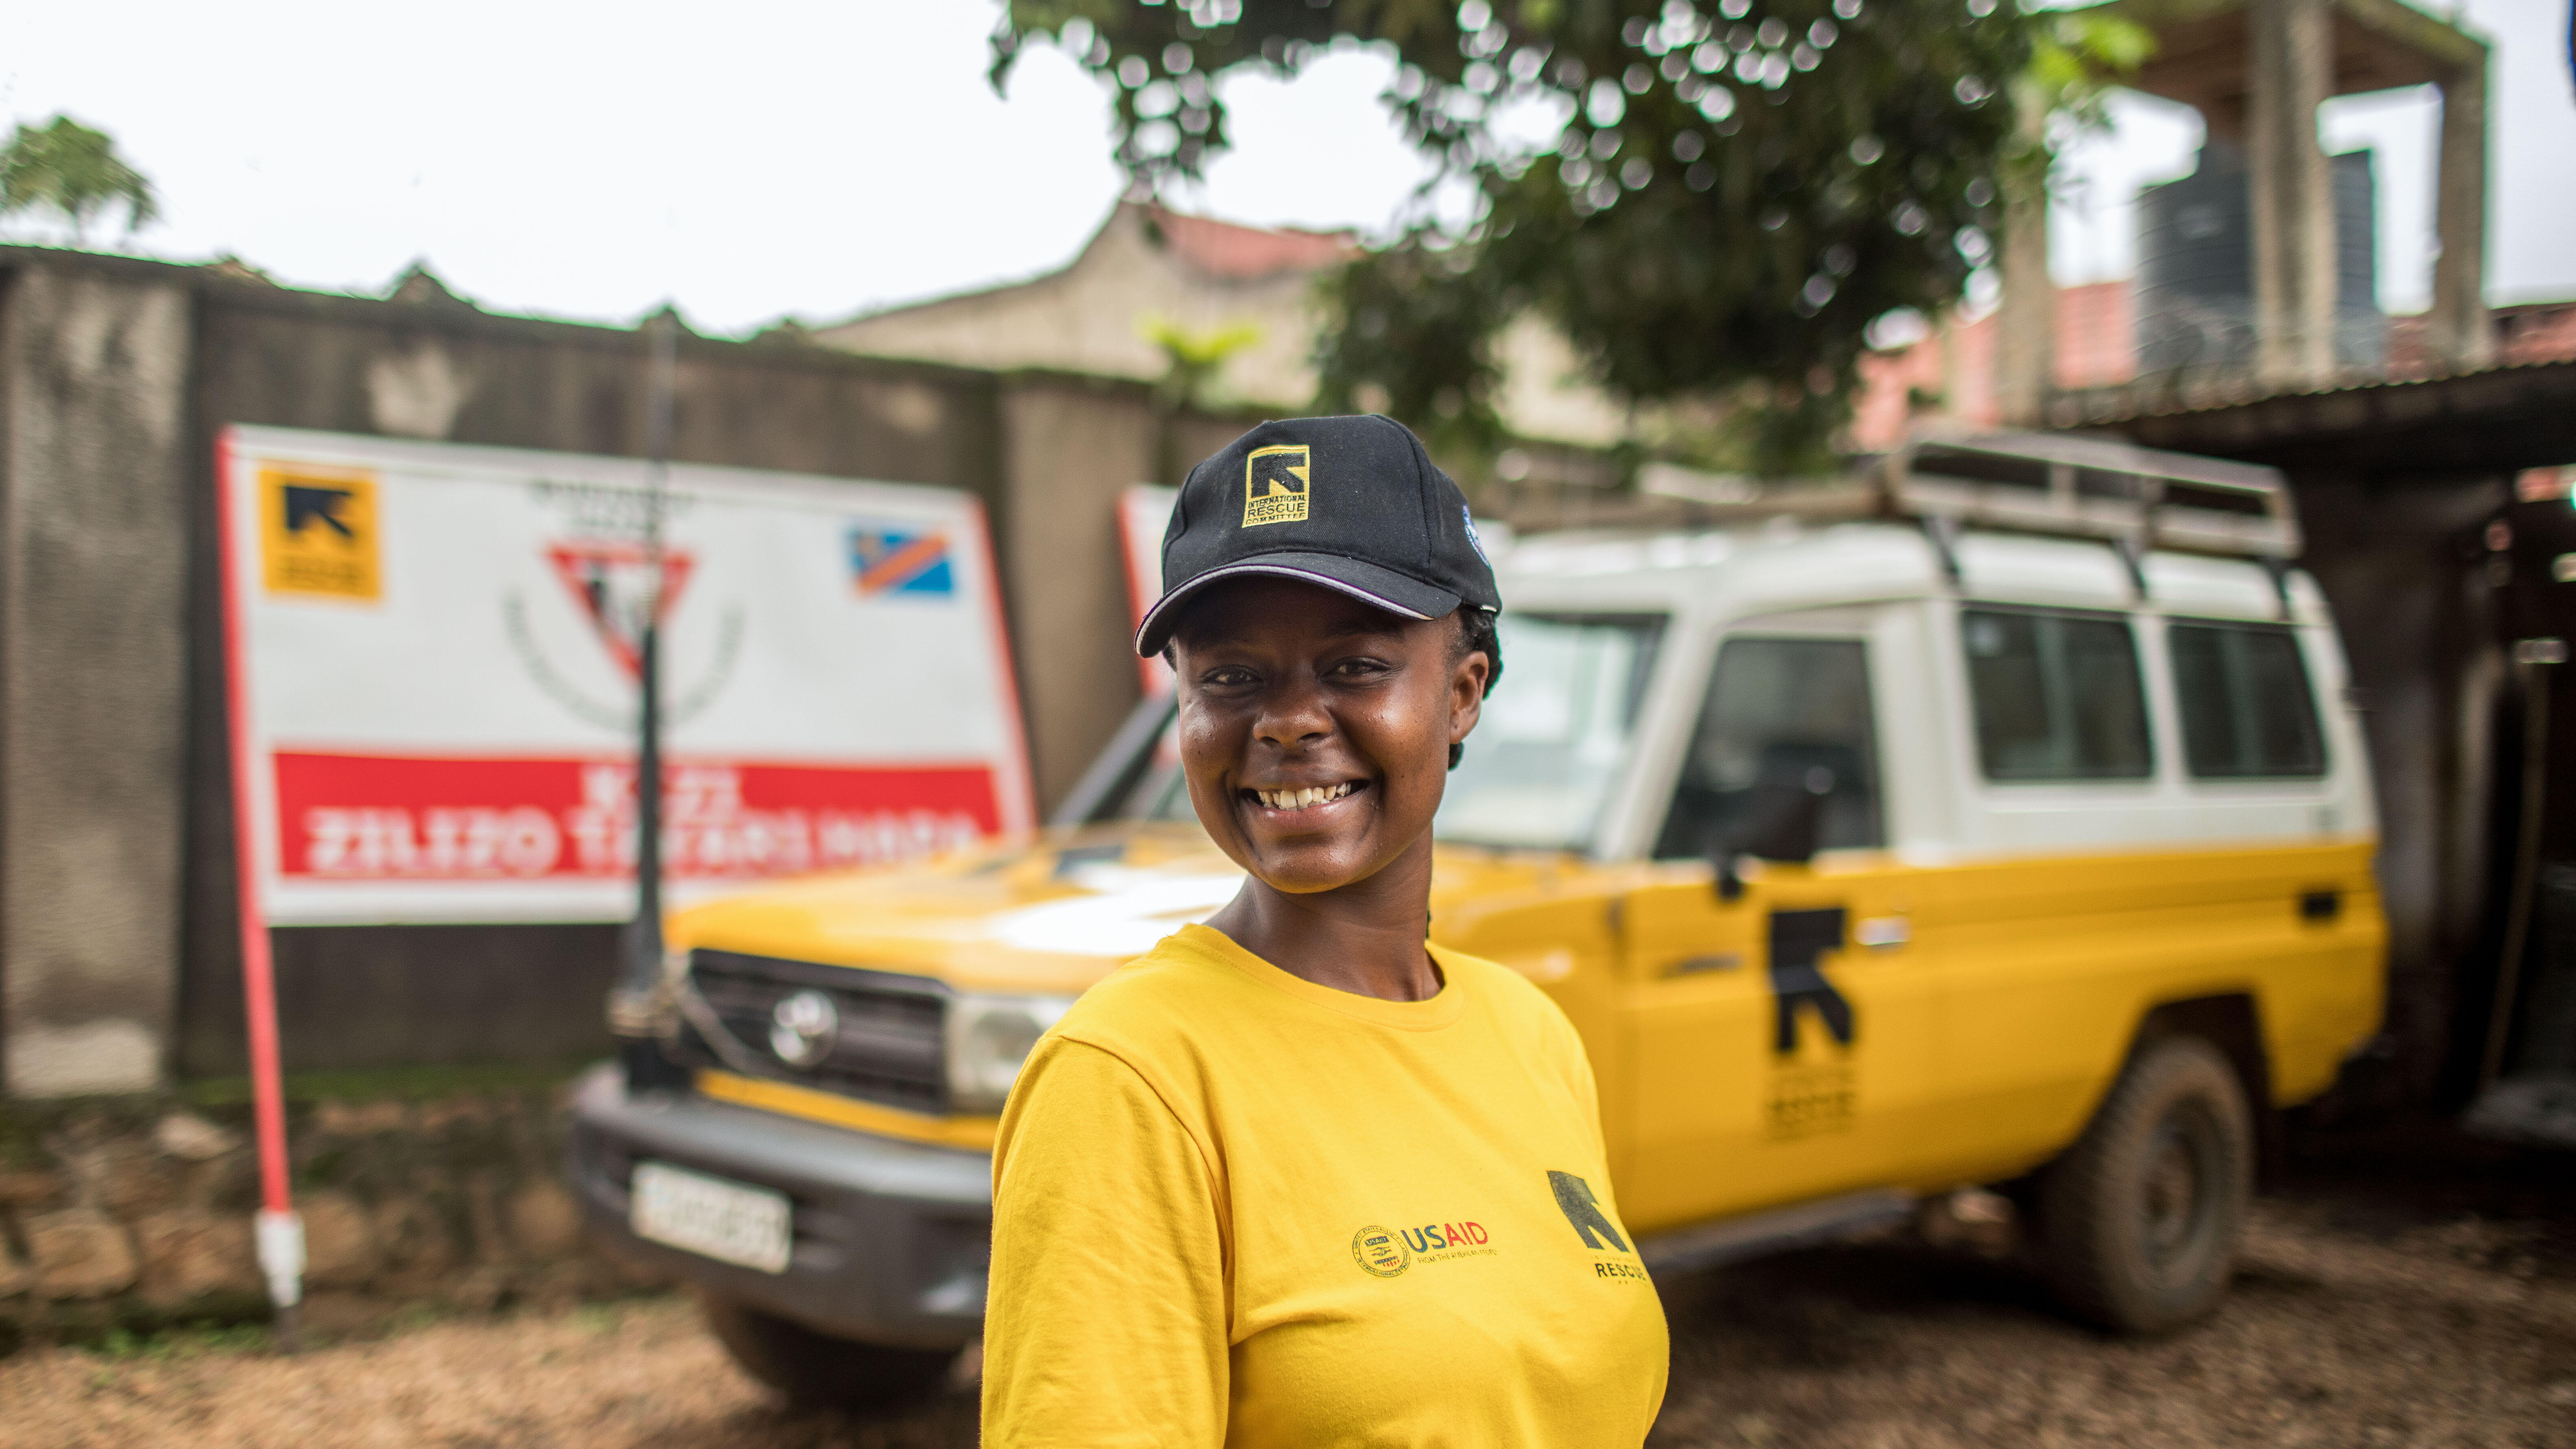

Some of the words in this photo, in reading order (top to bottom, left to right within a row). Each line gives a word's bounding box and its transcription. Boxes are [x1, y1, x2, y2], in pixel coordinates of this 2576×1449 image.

[1248, 494, 1306, 509] INTERNATIONAL
[1248, 502, 1306, 518] RESCUE
[1246, 512, 1306, 525] COMMITTEE
[1400, 1221, 1488, 1254] USAID
[1417, 1256, 1437, 1264] FROM
[1436, 1254, 1450, 1262] THE
